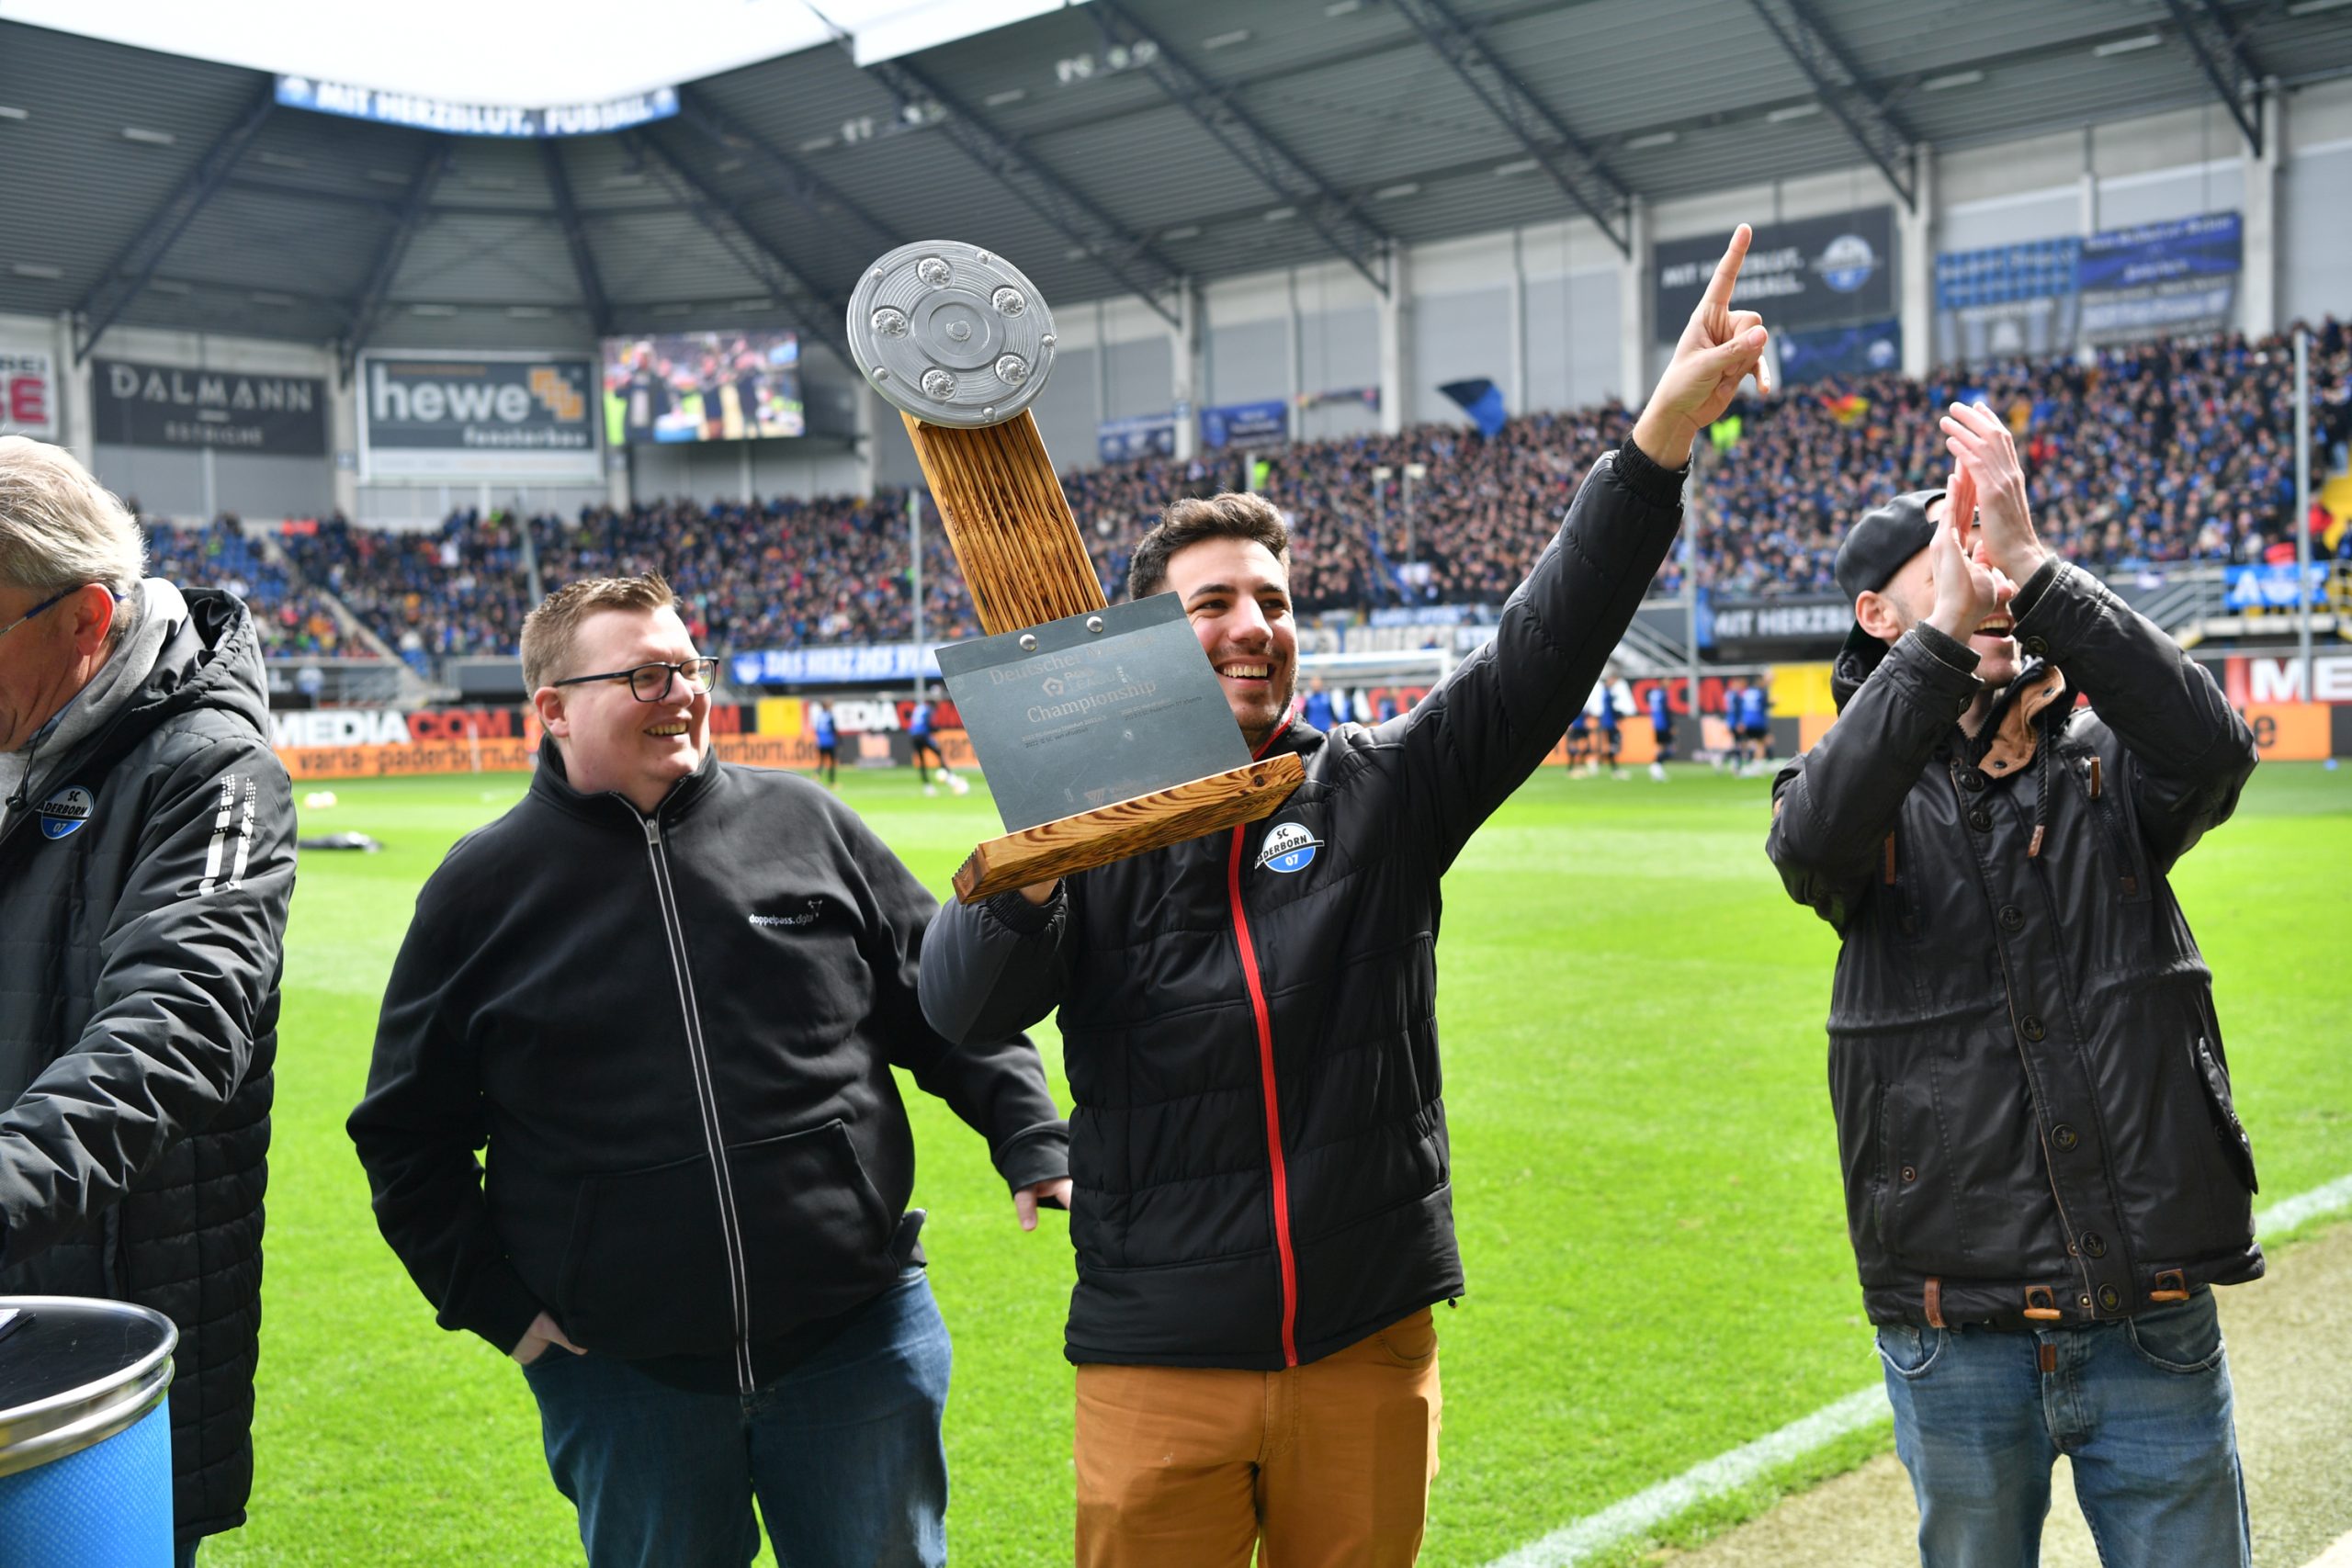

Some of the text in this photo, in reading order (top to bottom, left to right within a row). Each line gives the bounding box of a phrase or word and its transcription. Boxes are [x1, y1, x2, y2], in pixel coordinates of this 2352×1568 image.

[108, 363, 313, 413] DALMANN
[372, 363, 529, 423] hewe
[1027, 680, 1157, 724] Championship
[68, 791, 80, 802] SC
[53, 823, 67, 832] 07
[1276, 828, 1289, 840] SC
[1285, 853, 1299, 866] 07
